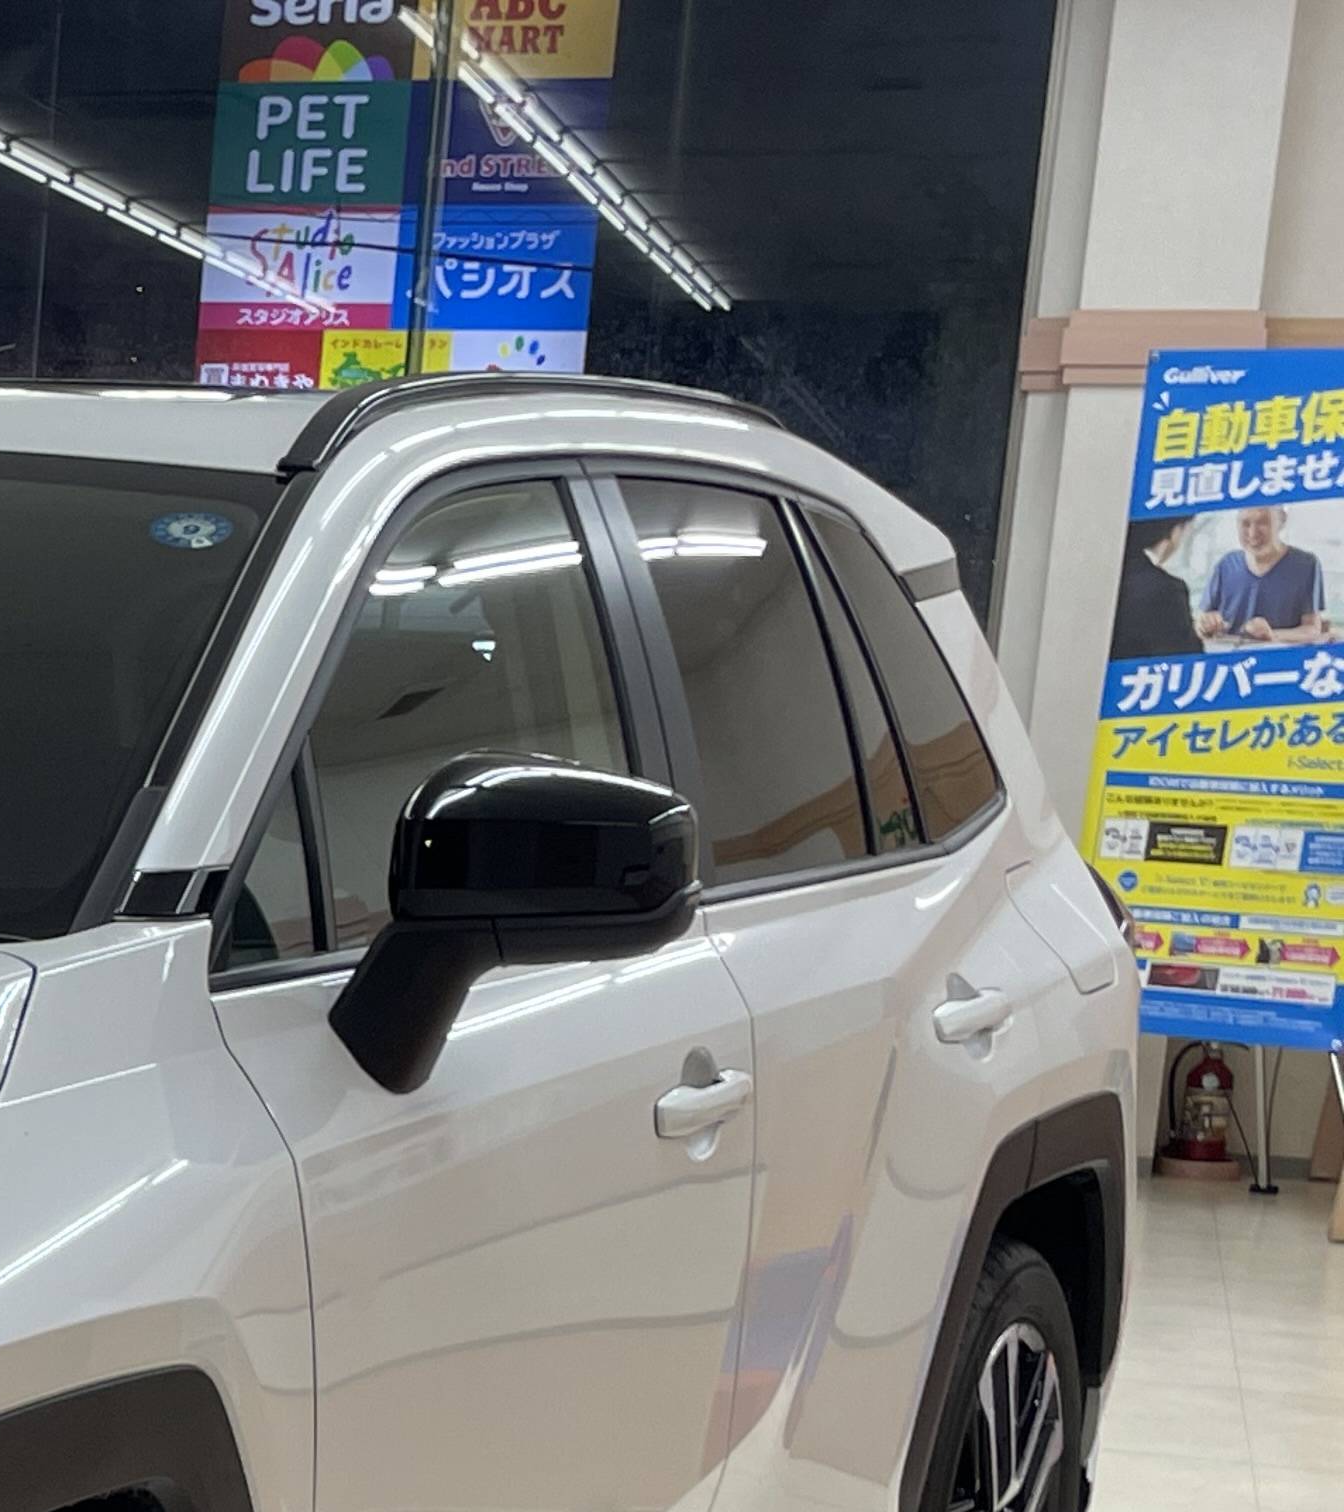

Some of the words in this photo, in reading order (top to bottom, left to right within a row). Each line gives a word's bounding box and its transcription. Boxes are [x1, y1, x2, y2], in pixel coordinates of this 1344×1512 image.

[256, 95, 370, 140] PET
[245, 148, 368, 194] LIFE
[431, 229, 561, 251] ファッションプラザ
[265, 250, 353, 299] Alice
[236, 308, 350, 327] スタジオアリス
[1162, 366, 1249, 385] Gulliver
[1153, 388, 1344, 462] 自動車保
[1144, 450, 1344, 510] 見直しませ
